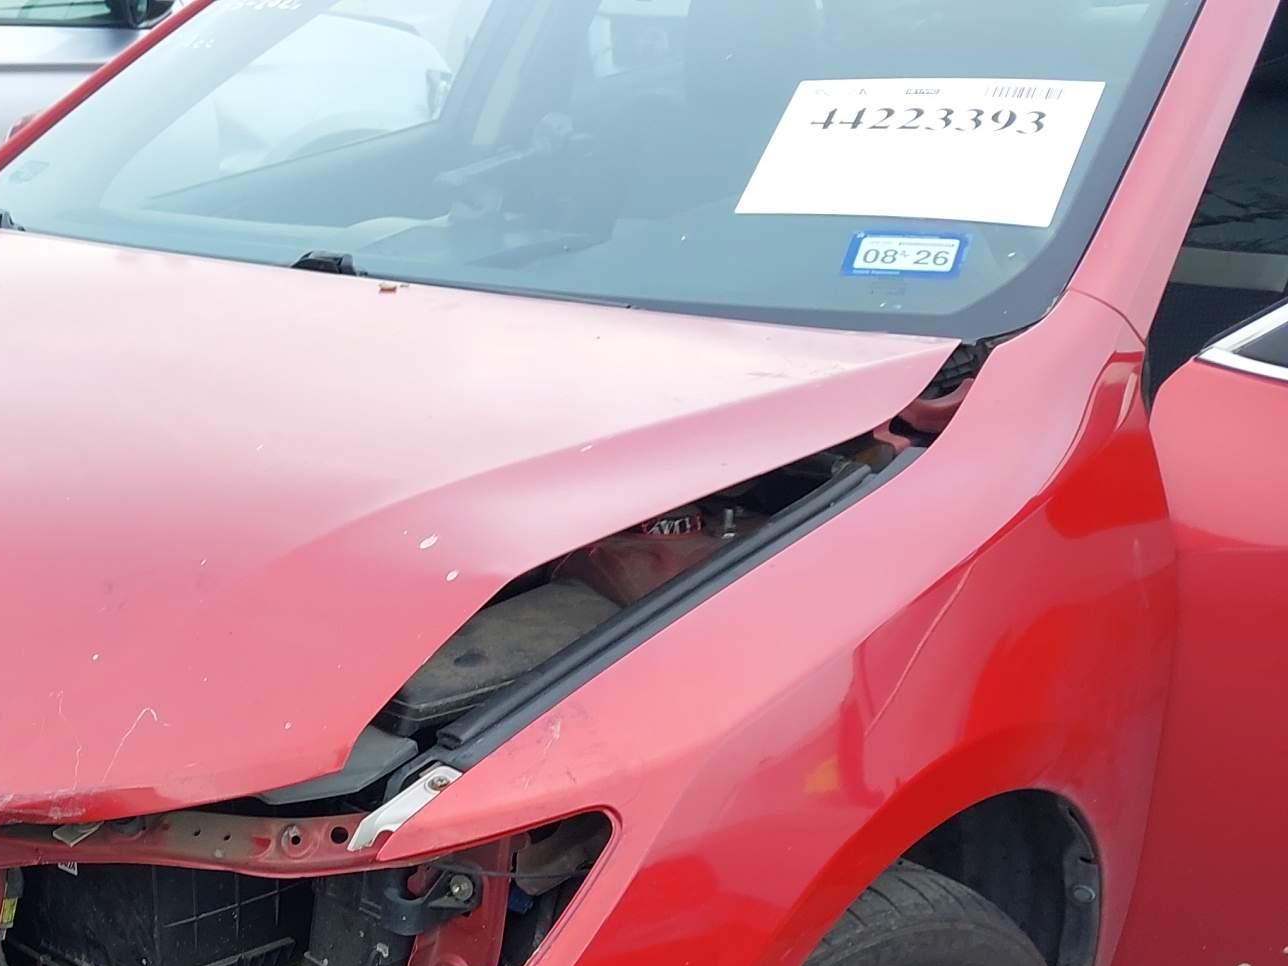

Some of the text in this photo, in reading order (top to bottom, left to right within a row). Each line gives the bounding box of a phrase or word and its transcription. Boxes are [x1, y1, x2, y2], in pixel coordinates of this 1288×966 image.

[810, 107, 1047, 135] 44223393
[862, 248, 950, 266] 08 26
